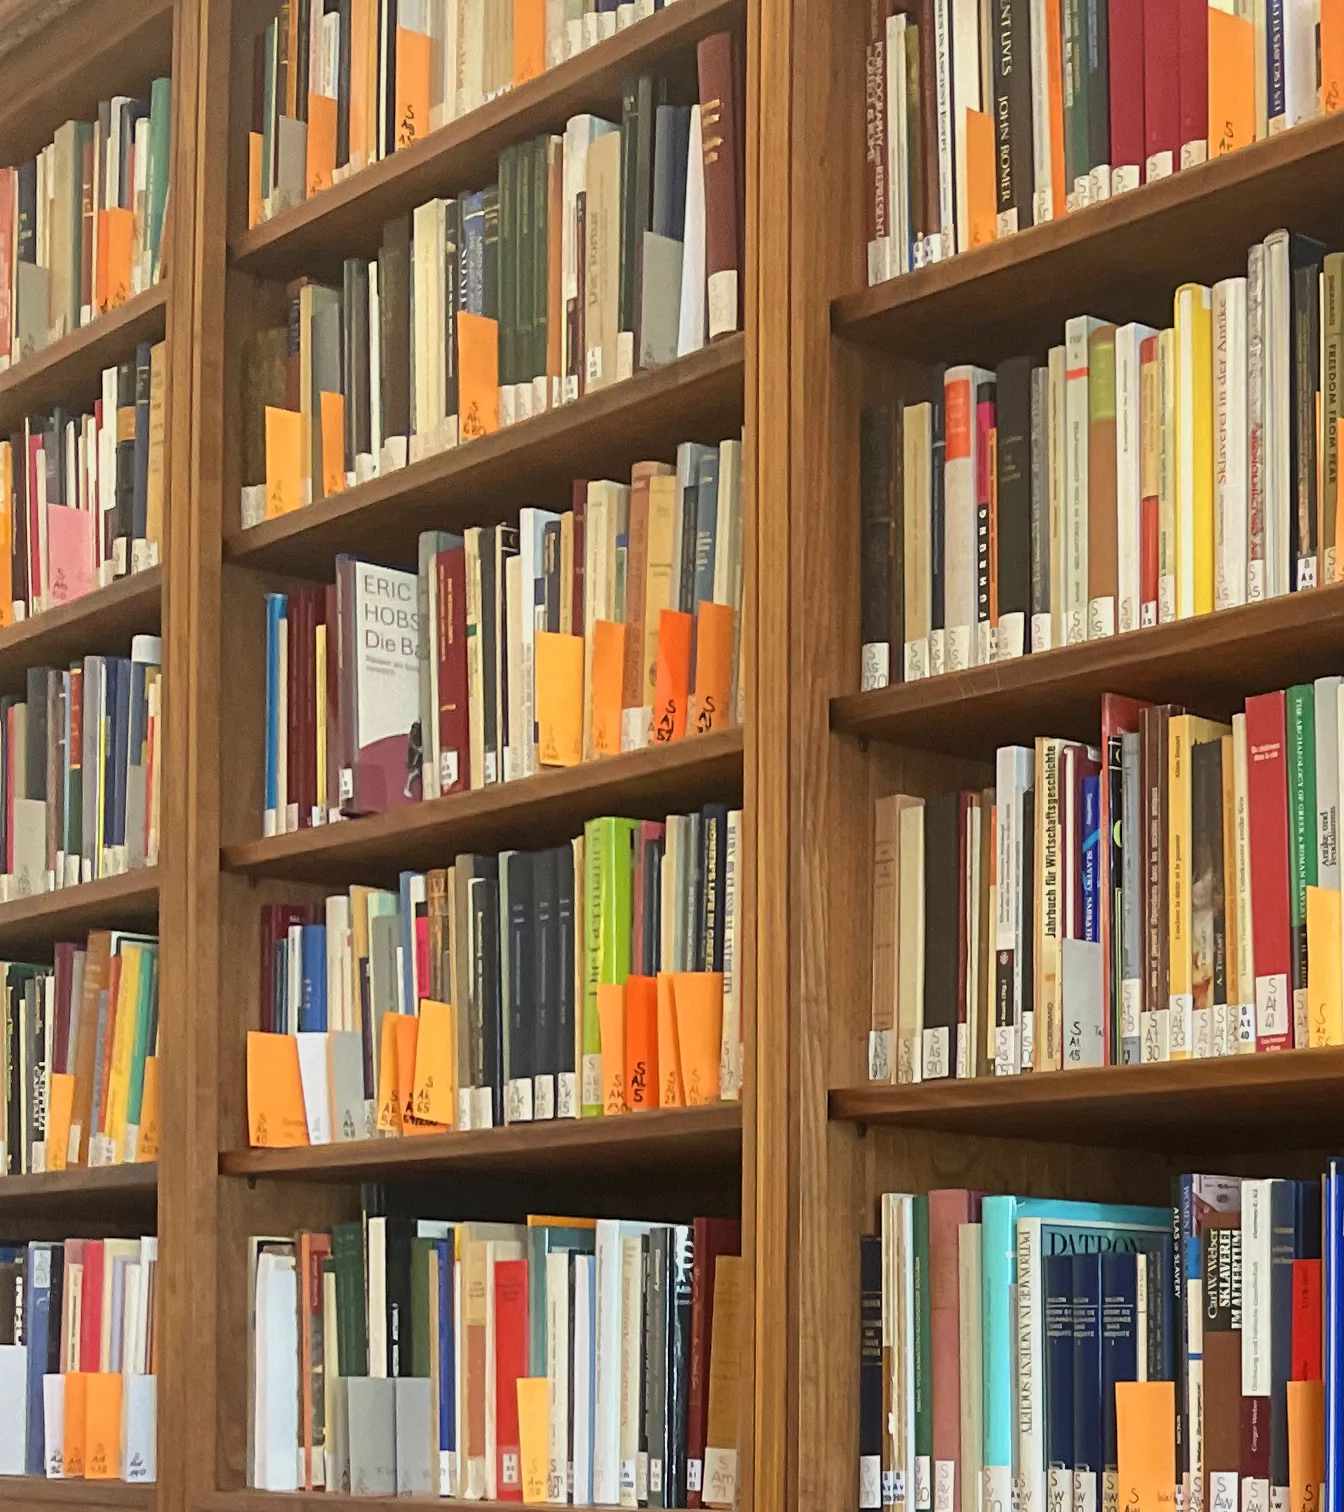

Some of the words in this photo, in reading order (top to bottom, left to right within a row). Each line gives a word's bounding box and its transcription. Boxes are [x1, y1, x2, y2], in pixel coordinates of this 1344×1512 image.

[1000, 146, 1012, 202] ROMER
[364, 574, 412, 602] ERIC
[364, 628, 397, 653] Die
[1045, 744, 1057, 866] Wirtschaftsgeschichte
[1045, 868, 1057, 886] für
[1045, 889, 1057, 939] Jahrbuch
